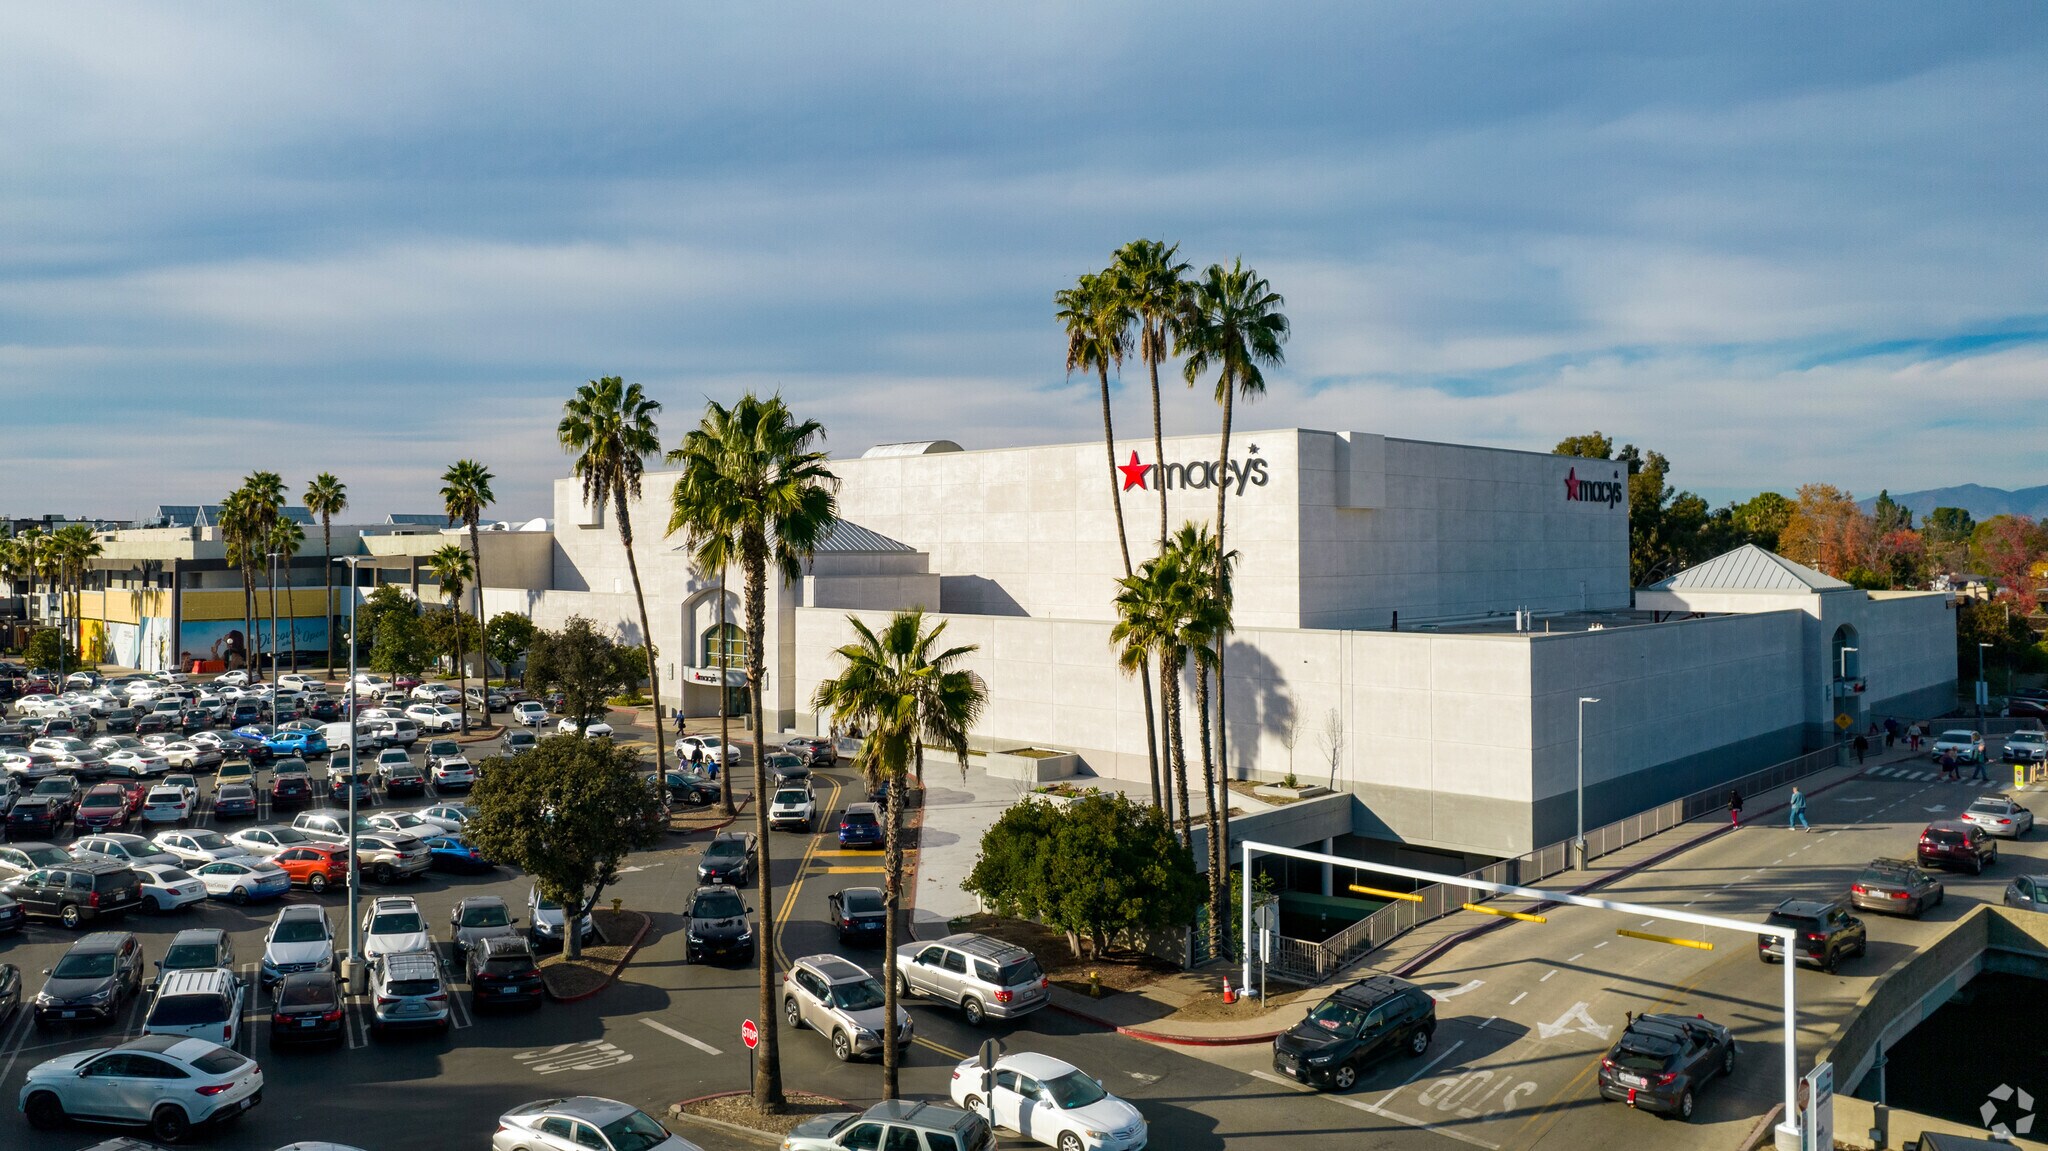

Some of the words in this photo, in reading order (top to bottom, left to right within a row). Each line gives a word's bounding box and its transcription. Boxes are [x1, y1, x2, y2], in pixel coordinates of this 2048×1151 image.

[1580, 470, 1622, 509] macy's
[255, 625, 303, 648] Dicovr
[743, 1027, 757, 1041] STOP
[512, 1039, 633, 1075] STOP
[1417, 1067, 1538, 1124] STOP
